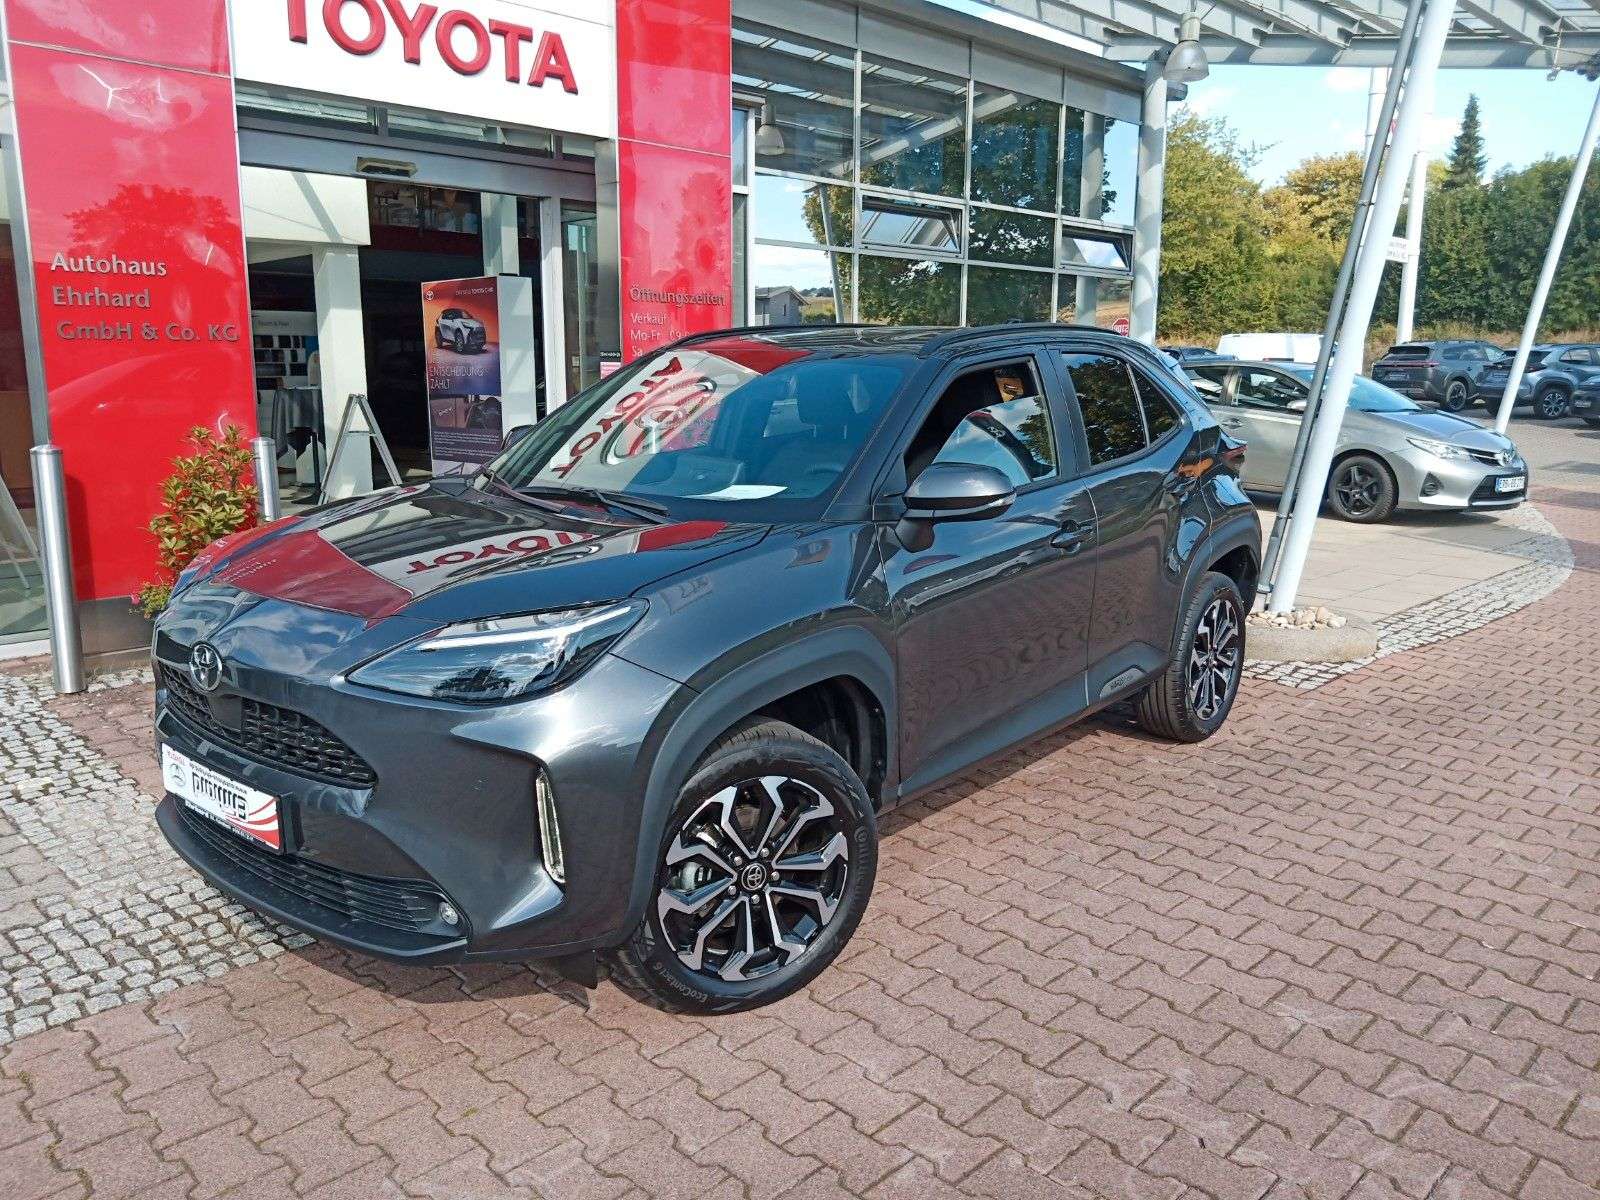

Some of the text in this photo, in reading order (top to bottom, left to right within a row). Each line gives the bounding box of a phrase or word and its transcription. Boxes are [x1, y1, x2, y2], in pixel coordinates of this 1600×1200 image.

[50, 252, 167, 276] Autohaus
[53, 286, 151, 309] Ehrhard
[629, 283, 725, 308] Öffnungszeiten
[630, 312, 667, 325] Verkauf
[57, 320, 240, 342] GmbH & Co. KG
